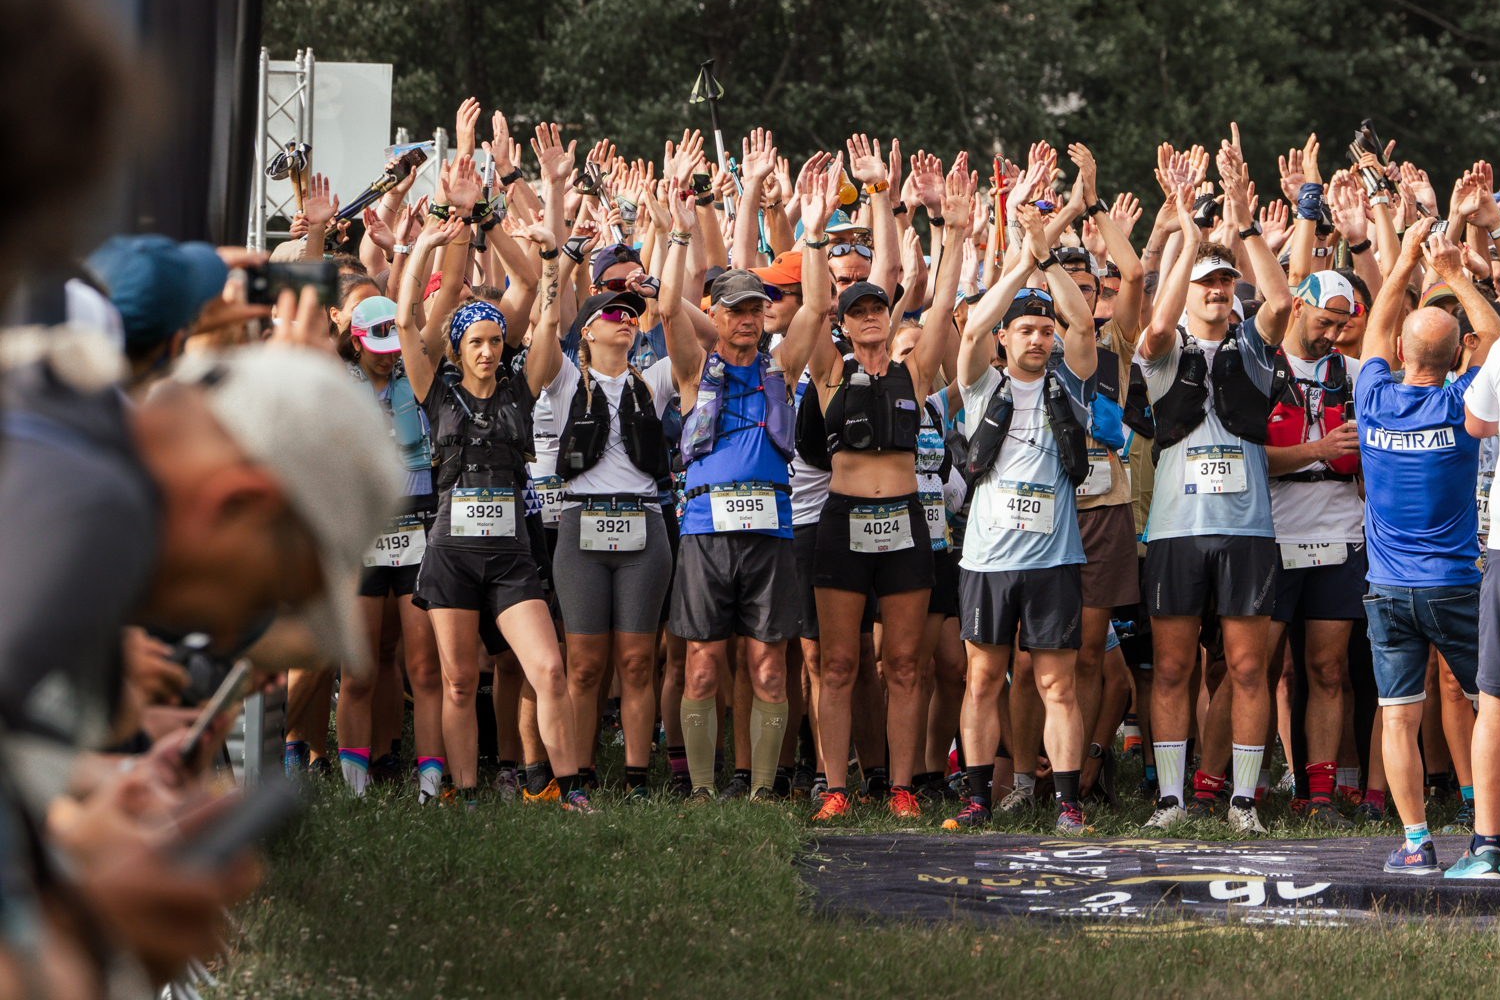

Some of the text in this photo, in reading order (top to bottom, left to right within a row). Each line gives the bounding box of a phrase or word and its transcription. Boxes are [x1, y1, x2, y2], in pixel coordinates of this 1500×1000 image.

[1366, 427, 1456, 450] LIVETRAIL
[917, 450, 944, 461] neider
[1200, 461, 1231, 476] 3751
[466, 505, 503, 518] 3929
[726, 499, 764, 513] 3995
[1006, 497, 1042, 514] 4120
[596, 520, 630, 533] 3921
[863, 520, 900, 535] 4024
[375, 535, 410, 551] 4193
[1404, 854, 1422, 865] HOKA
